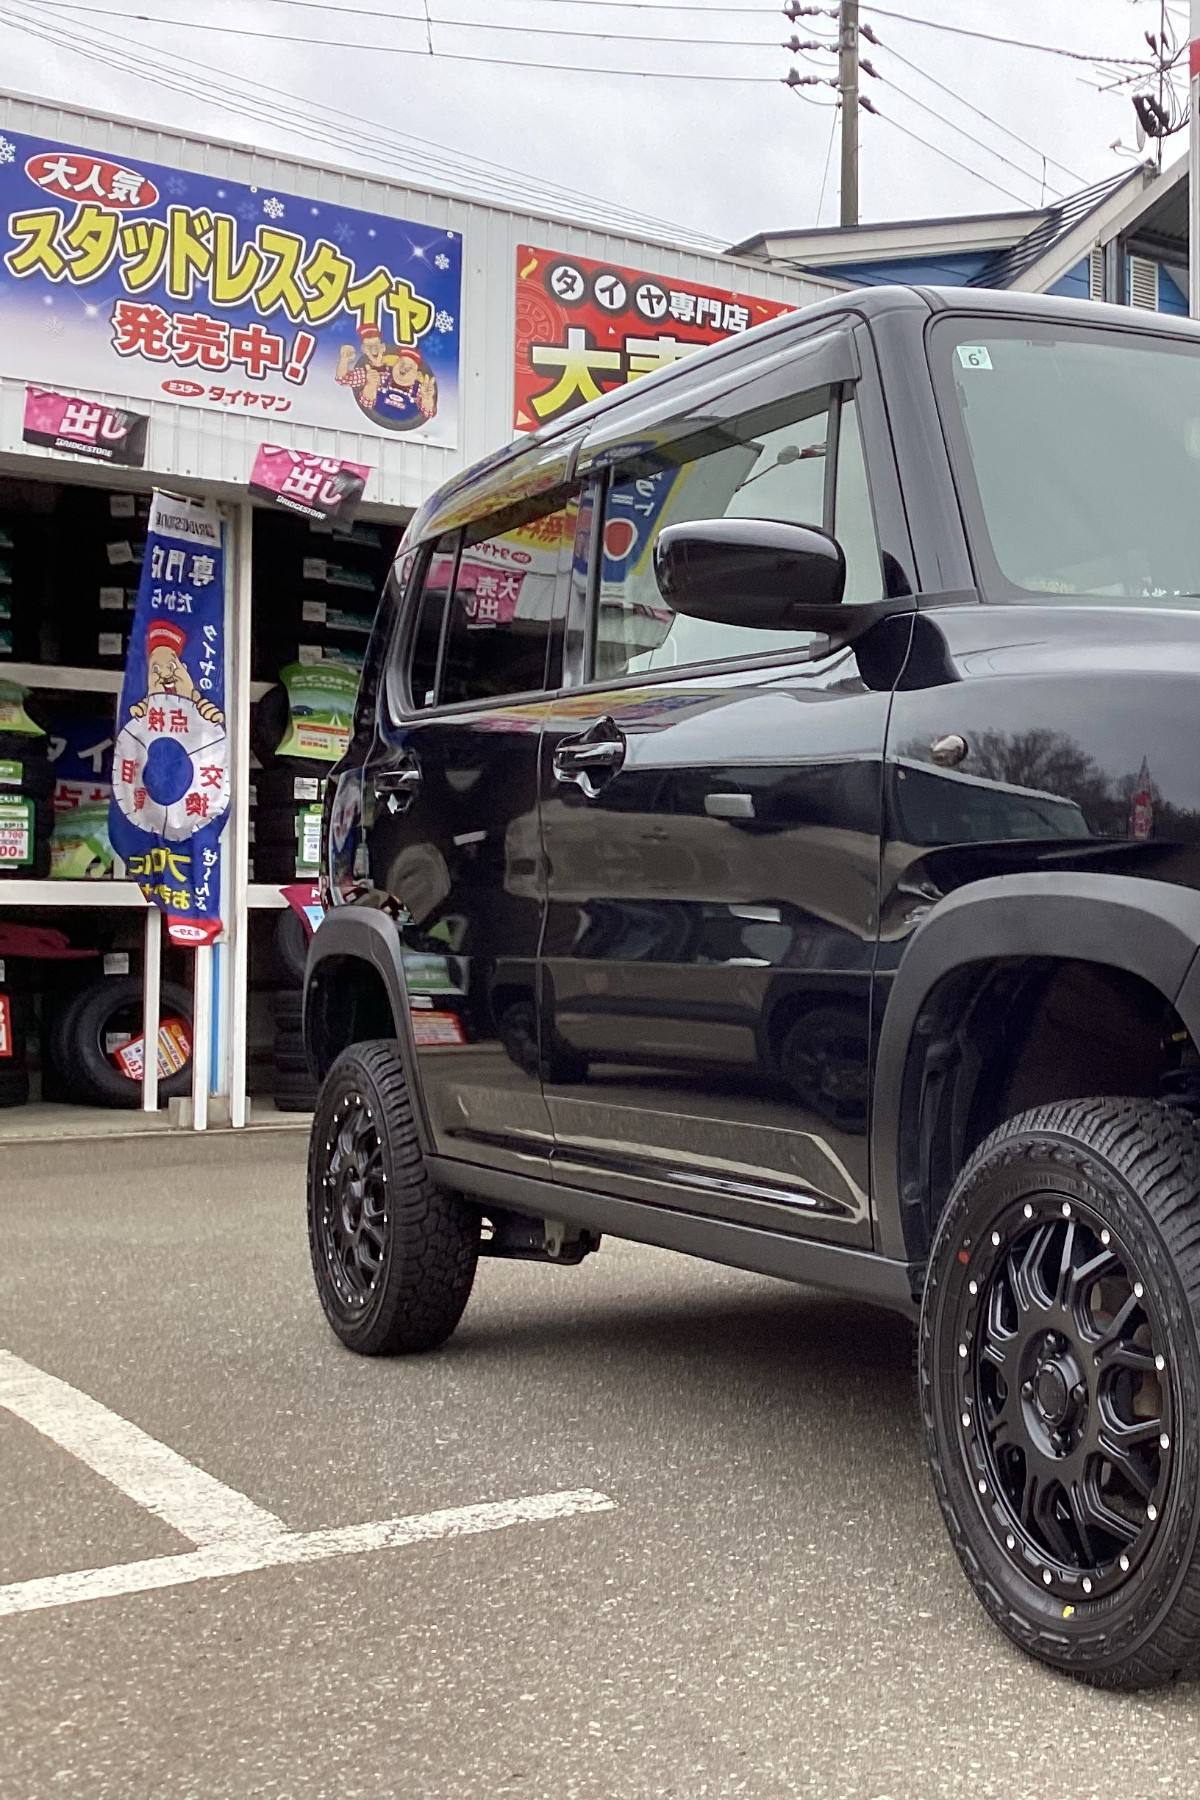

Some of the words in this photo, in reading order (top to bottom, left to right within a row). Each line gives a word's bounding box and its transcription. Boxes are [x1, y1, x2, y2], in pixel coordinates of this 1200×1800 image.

[39, 156, 147, 206] 大人気
[10, 207, 433, 343] スタッドレスタイヤ
[553, 266, 749, 332] タイヤ専門店
[114, 301, 314, 383] 発売中!
[968, 353, 980, 366] 6
[168, 382, 200, 394] ミスター
[208, 386, 291, 412] タイヤマン
[59, 404, 128, 440] 出し
[55, 437, 113, 458] BRIDGESTONE
[281, 466, 342, 504] 出し
[276, 494, 328, 520] BRIDGESTONE
